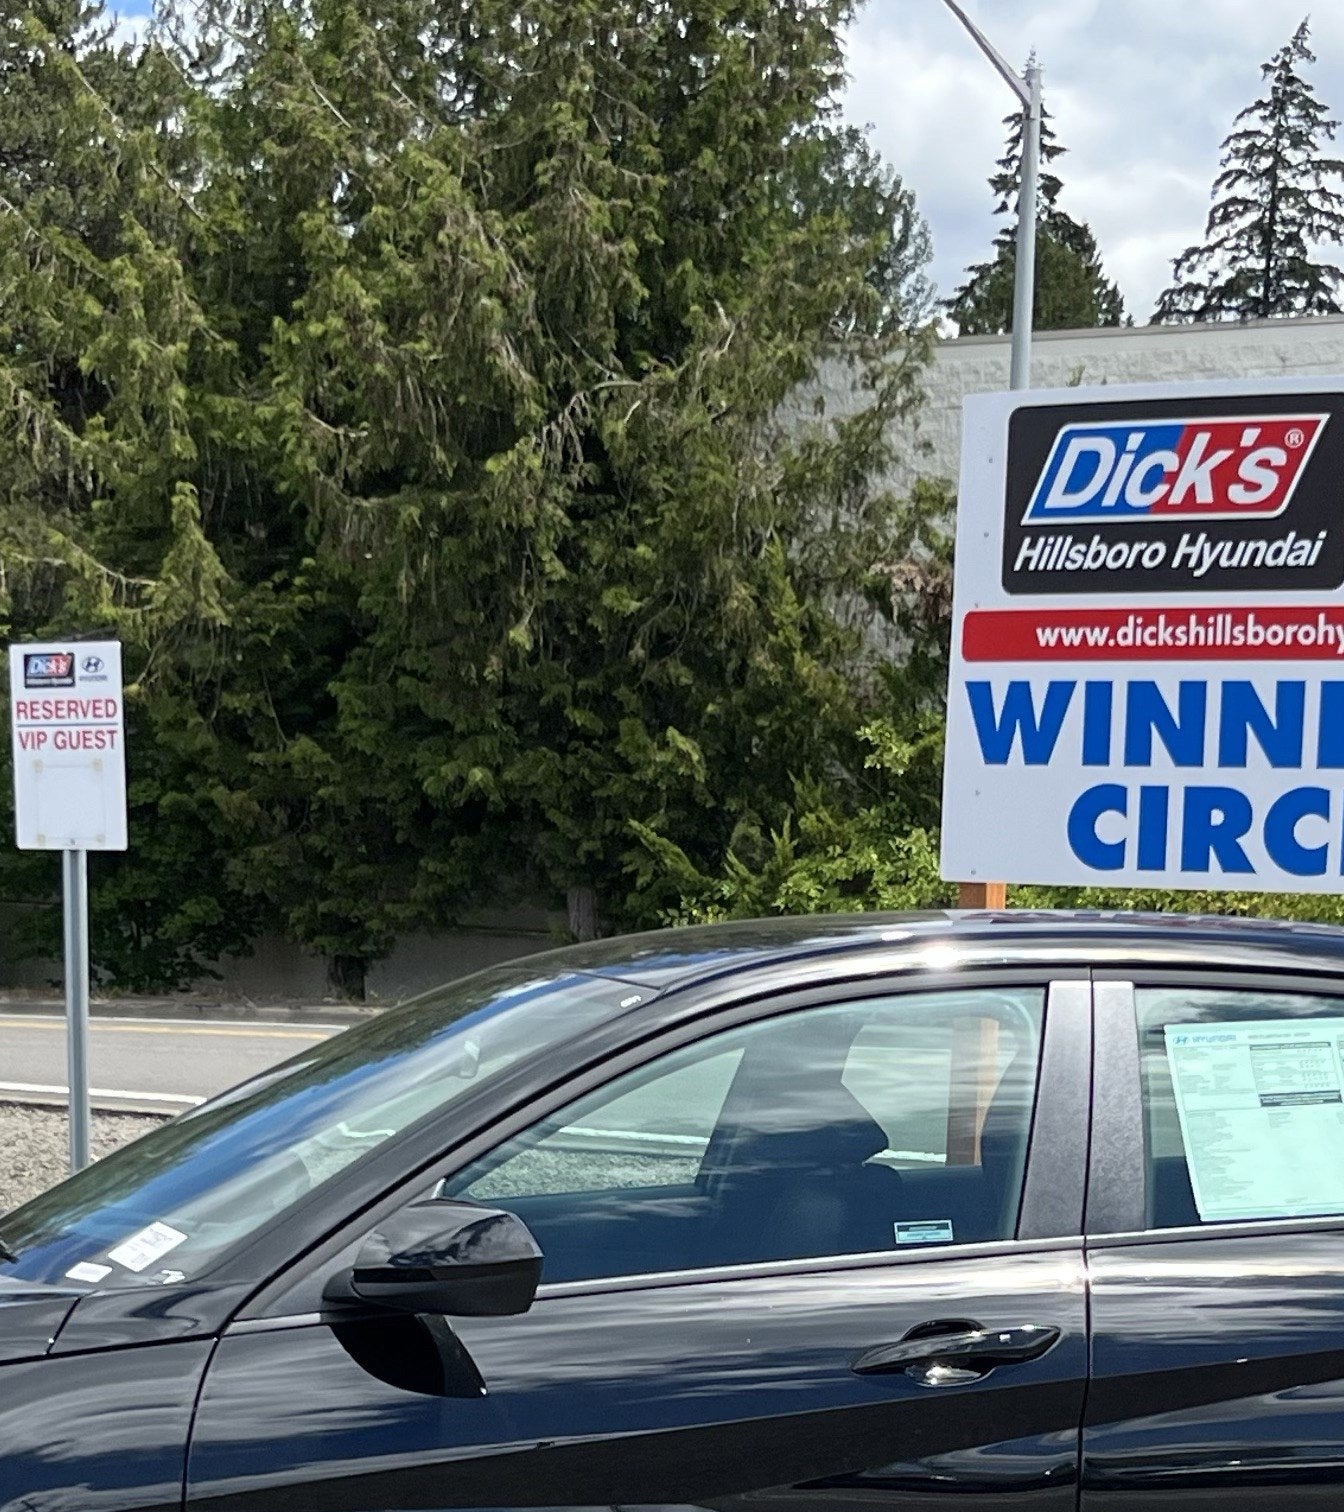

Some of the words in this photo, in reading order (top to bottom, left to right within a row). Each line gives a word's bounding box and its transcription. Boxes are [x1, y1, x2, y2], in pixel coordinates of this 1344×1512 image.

[1044, 427, 1288, 509] Dick's
[1013, 533, 1168, 572] Hillsboro
[1171, 529, 1328, 577] Hyundai
[16, 699, 118, 720] RESERVED
[18, 731, 48, 750] VIP
[53, 730, 118, 750] GUEST
